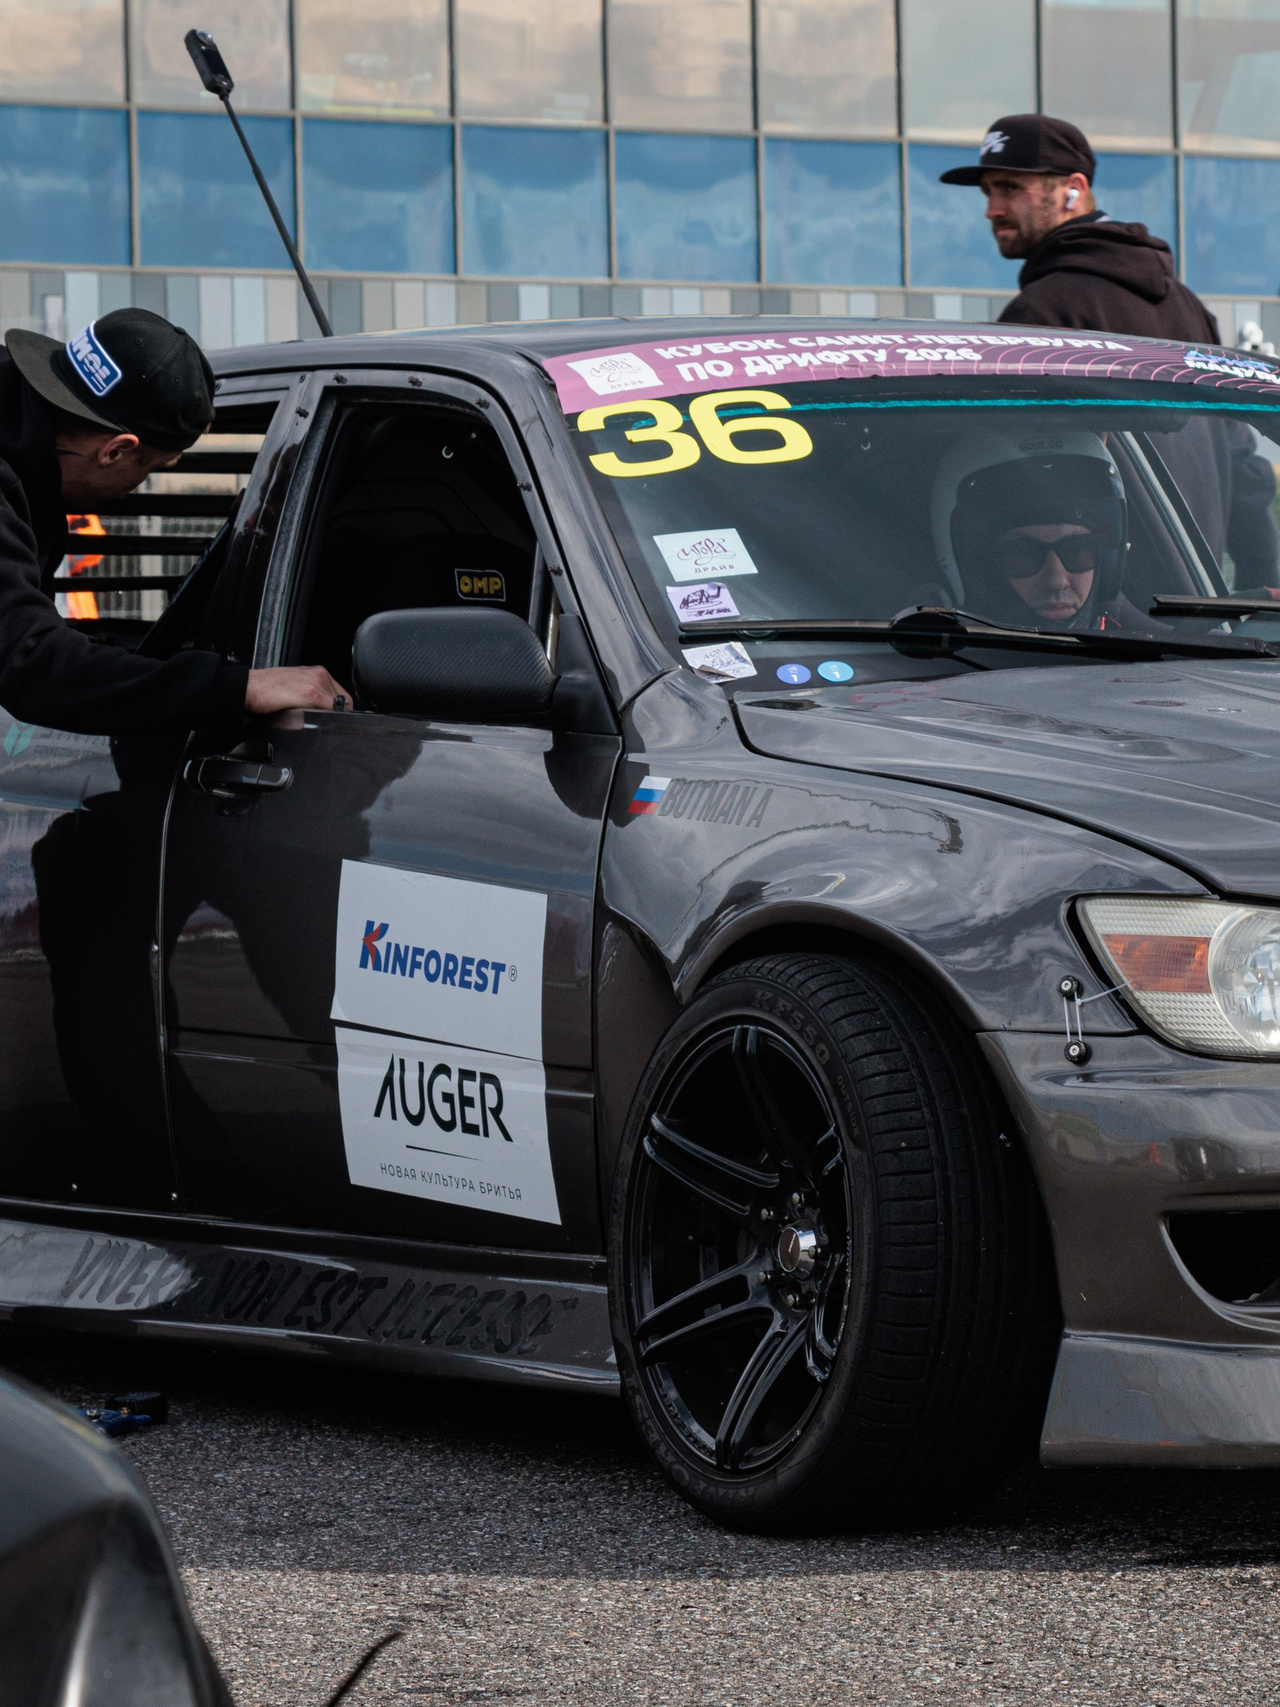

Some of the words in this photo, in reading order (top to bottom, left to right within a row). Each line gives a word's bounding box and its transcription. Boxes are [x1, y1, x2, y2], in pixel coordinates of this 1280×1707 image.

[654, 337, 783, 359] КУБОК
[788, 334, 1133, 351] САНКТ-ПЕТЕРБУРГА
[675, 359, 734, 382] ПО
[741, 348, 888, 377] ДРИФТУ
[896, 348, 983, 361] 2026
[577, 389, 813, 478] 36
[460, 575, 502, 595] OMP
[694, 563, 735, 574] ДРАЙВ
[750, 788, 774, 828] A
[359, 919, 507, 995] KINFOREST
[373, 1053, 514, 1143] AUGER
[837, 1074, 861, 1138] OUTSIDE
[380, 1162, 417, 1181] НОВАЯ
[421, 1171, 476, 1193] КУЛЬТУРА
[480, 1181, 523, 1202] БРИТЬЯ
[283, 1269, 389, 1335] EST
